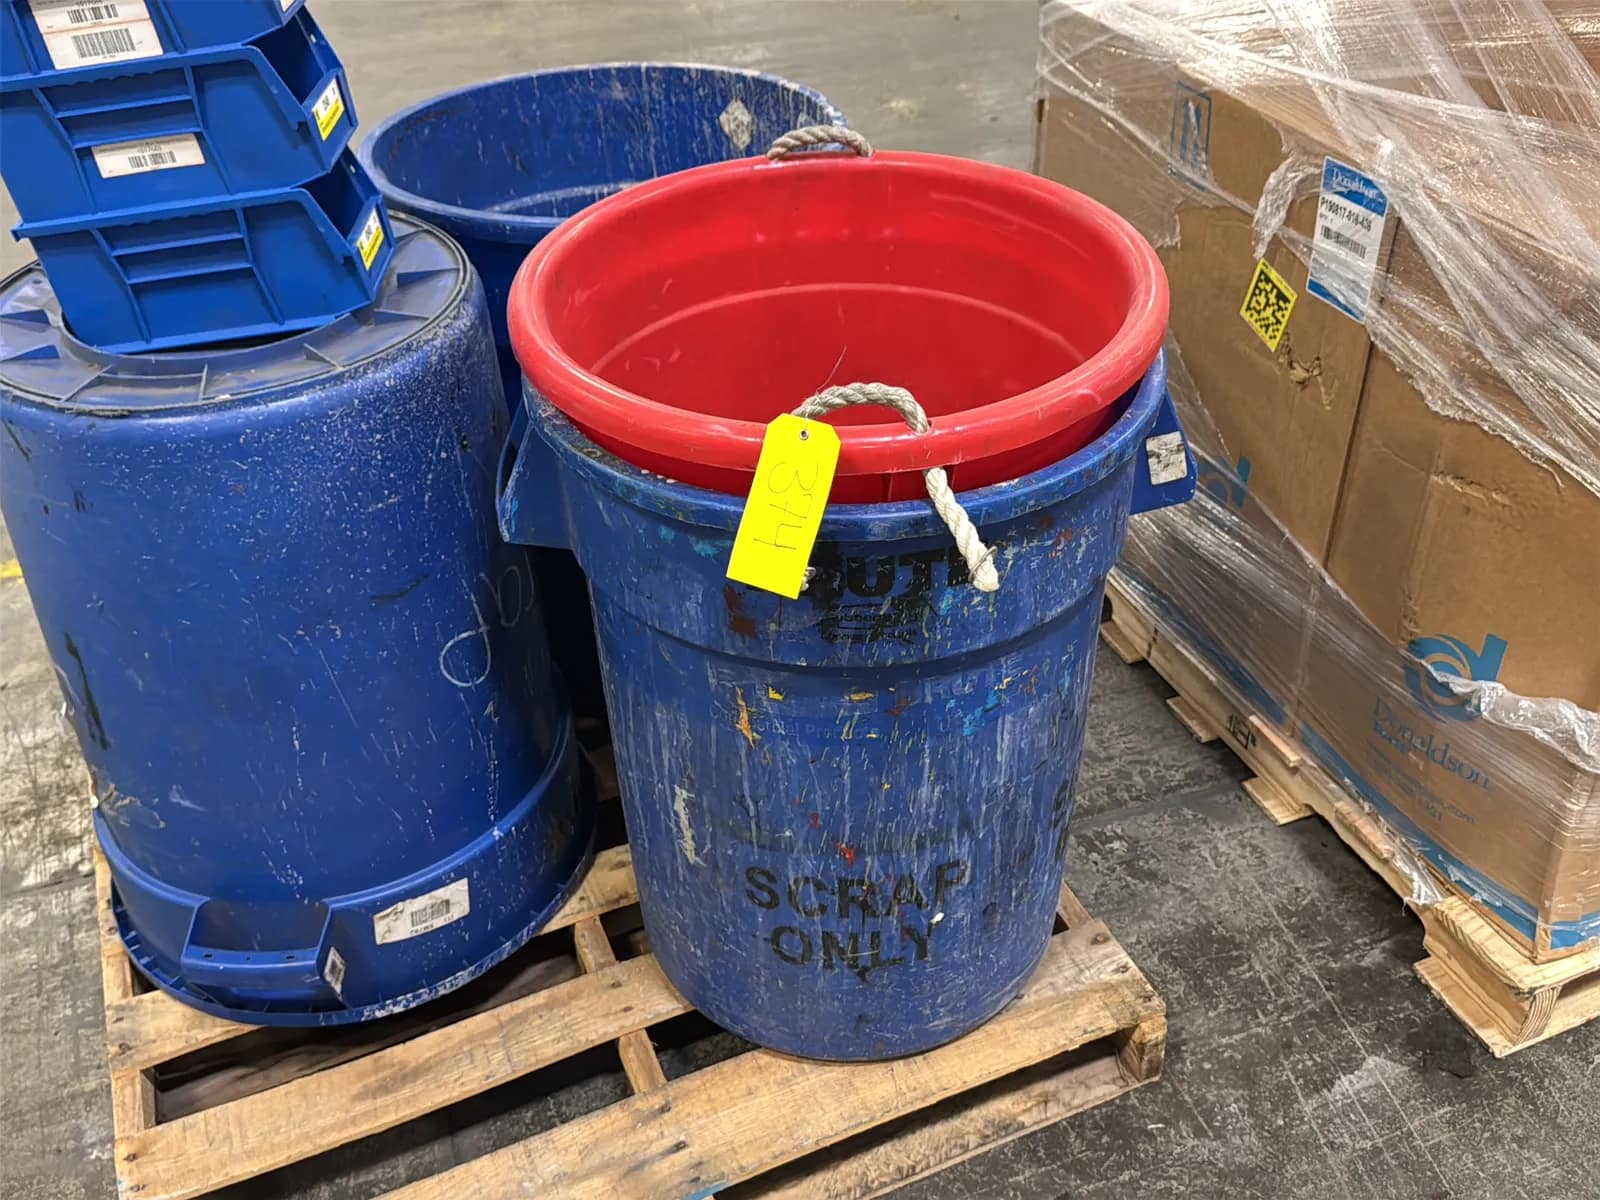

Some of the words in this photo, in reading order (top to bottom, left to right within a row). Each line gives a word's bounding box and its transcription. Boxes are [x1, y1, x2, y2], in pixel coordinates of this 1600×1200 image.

[752, 461, 819, 550] 374
[744, 859, 967, 918] SCRAP
[770, 918, 939, 970] ONLY
